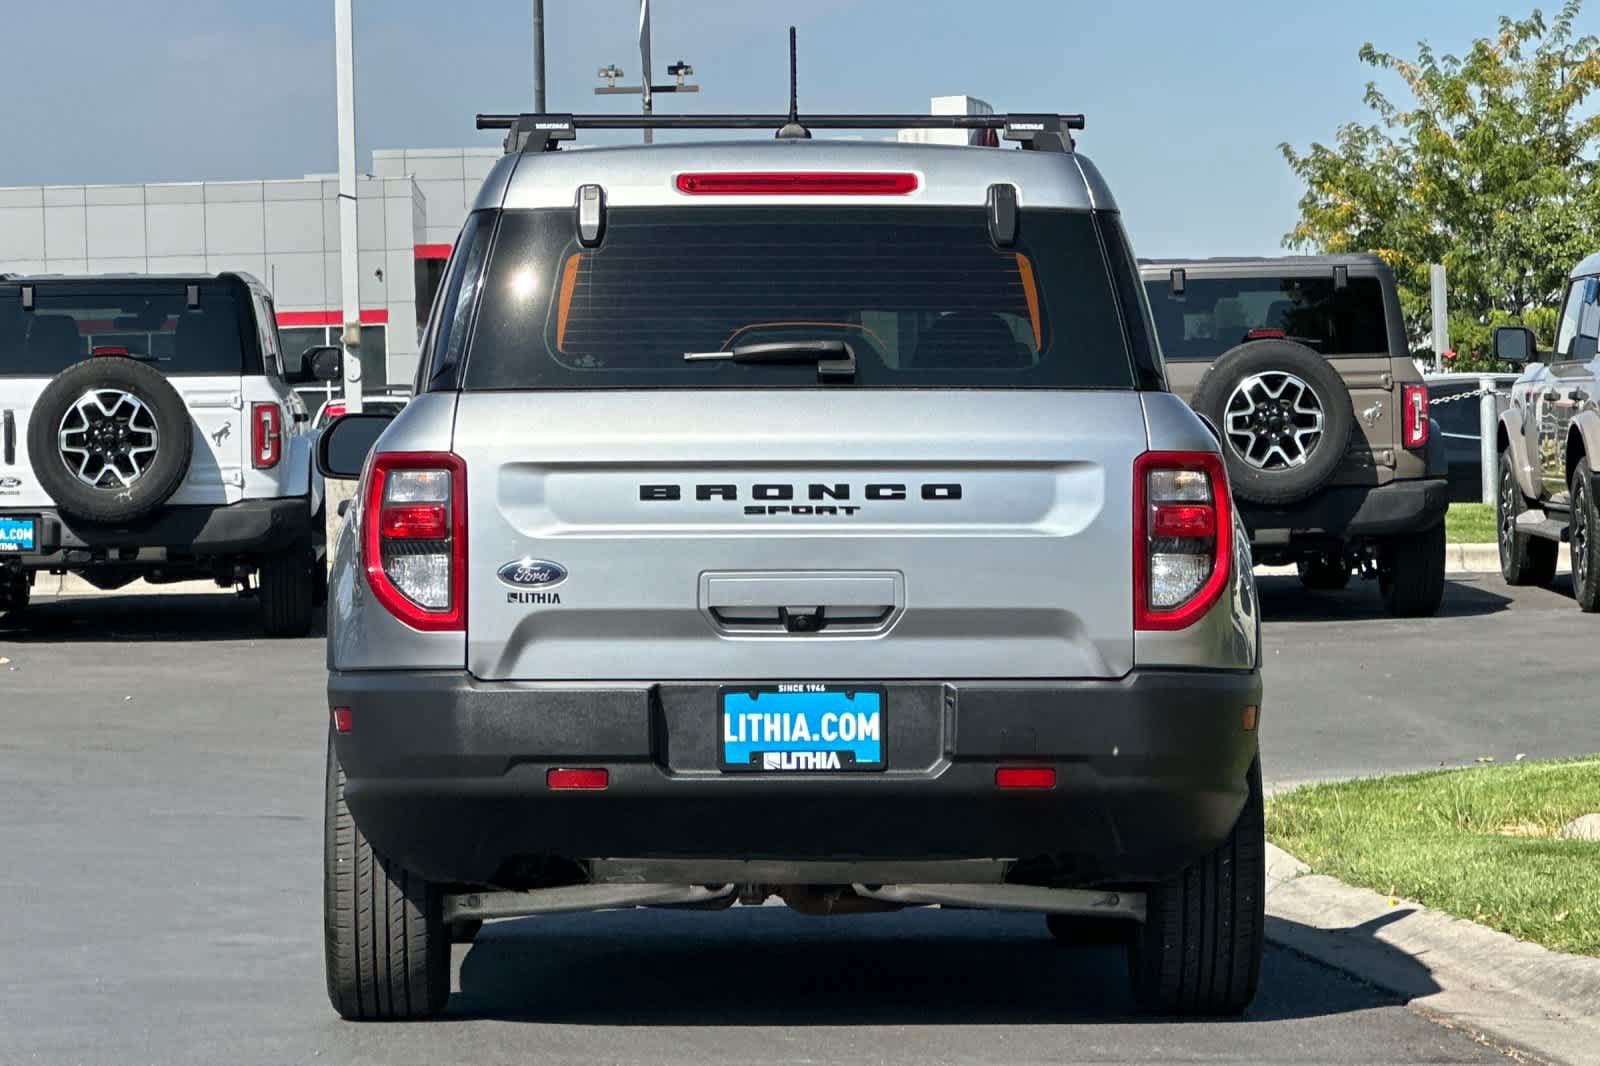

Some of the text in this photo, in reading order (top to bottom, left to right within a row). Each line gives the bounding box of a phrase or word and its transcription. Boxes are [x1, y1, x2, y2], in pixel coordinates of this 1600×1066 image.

[640, 484, 962, 501] BRONCO
[744, 505, 861, 515] SPORT
[513, 566, 551, 582] Ford
[519, 592, 561, 604] LITHIA
[778, 684, 826, 693] SINCE 1966
[724, 712, 880, 742] LITHIA.COM
[781, 751, 841, 769] LITHIA
